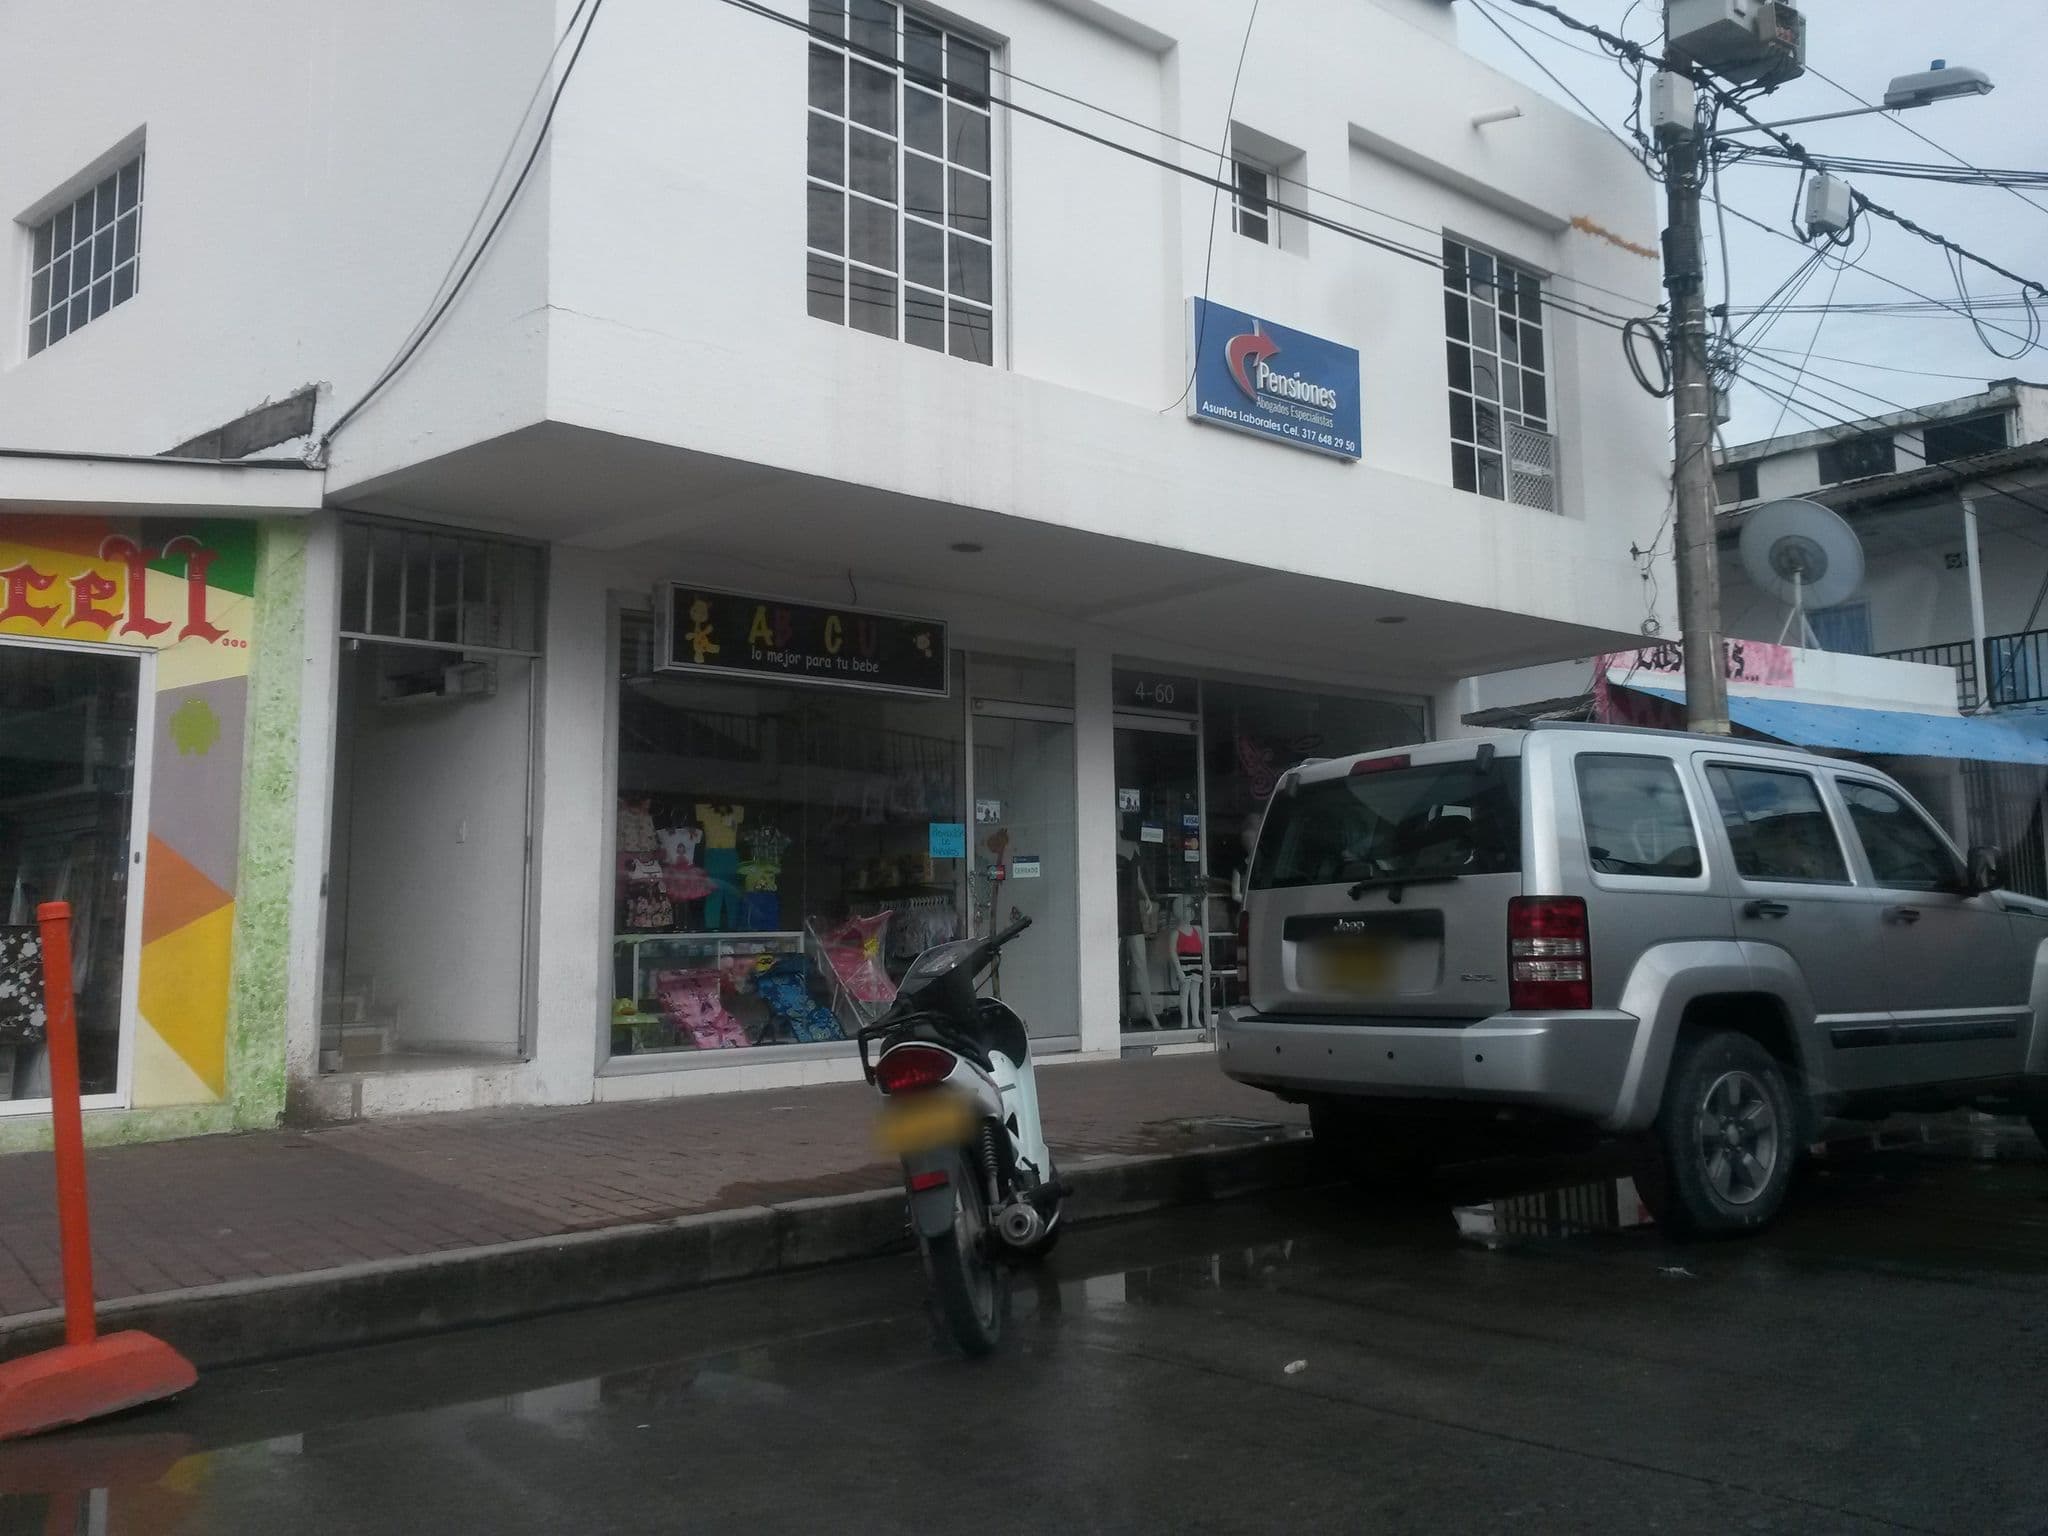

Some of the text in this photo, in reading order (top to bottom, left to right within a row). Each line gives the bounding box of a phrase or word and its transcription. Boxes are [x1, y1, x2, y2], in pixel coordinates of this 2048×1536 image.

[1257, 361, 1337, 410] Pensiones
[1202, 400, 1355, 452] Asuntos Laborales Cel. 317 648 29 50
[1256, 395, 1334, 429] Abogados Especialistas
[751, 645, 880, 673] lo mejor para tu bebe
[1136, 680, 1175, 704] 4-60
